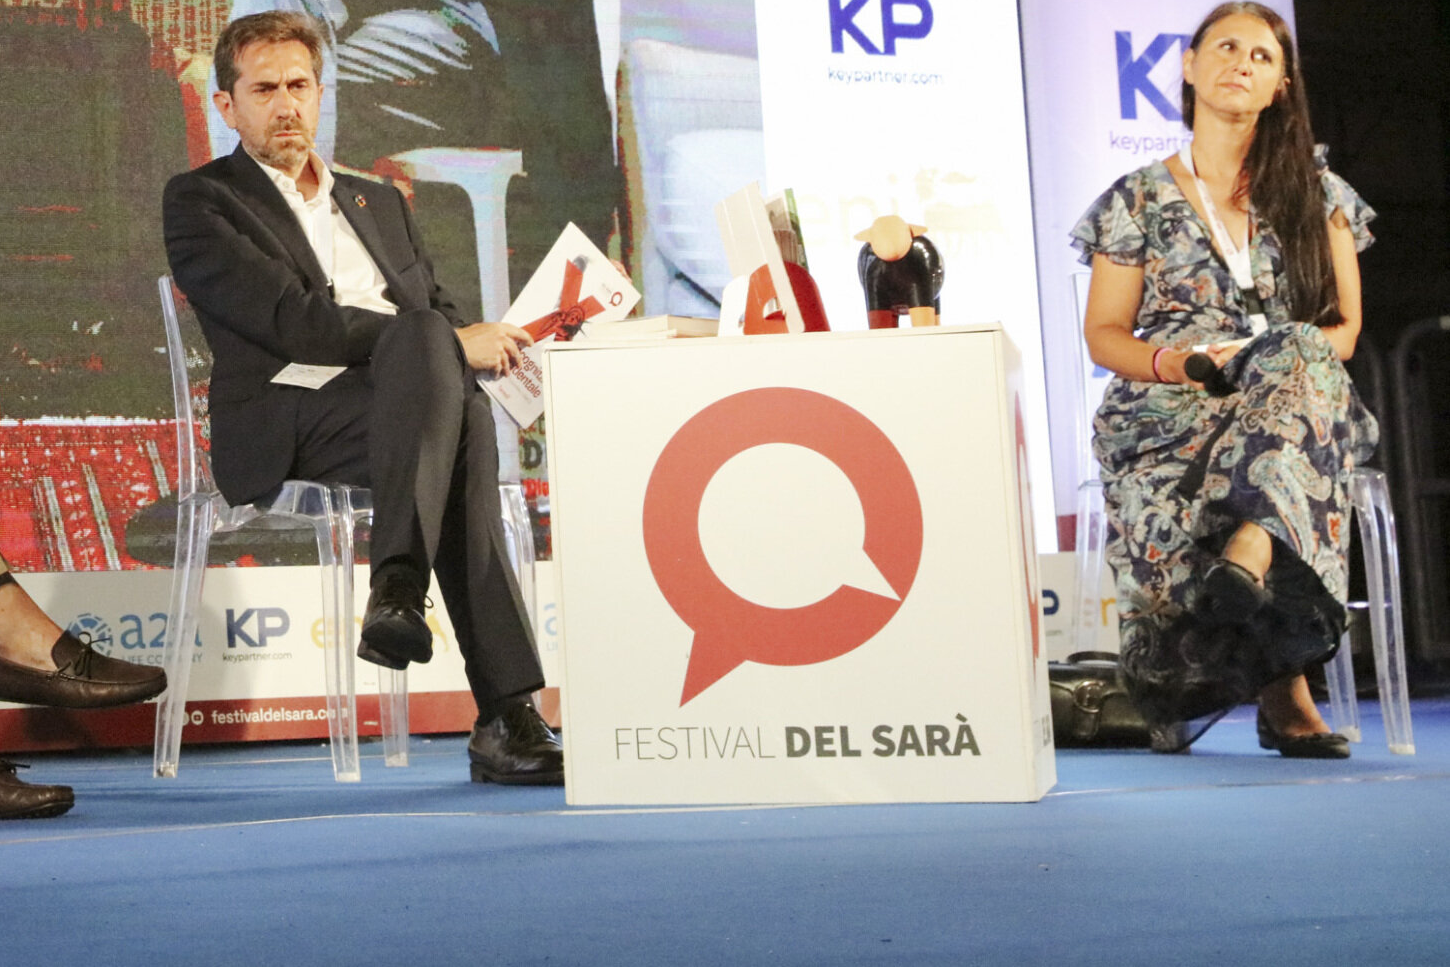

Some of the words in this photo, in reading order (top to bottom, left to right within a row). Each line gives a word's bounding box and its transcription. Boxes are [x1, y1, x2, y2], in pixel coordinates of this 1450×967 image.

[828, 66, 945, 86] keypartner.com
[1114, 30, 1192, 122] K
[1109, 130, 1190, 155] keypart
[225, 607, 290, 648] KP
[222, 651, 293, 664] keypartner.com
[615, 726, 775, 760] FESTIVAL
[785, 725, 861, 758] DEL
[872, 713, 981, 757] SARÀ
